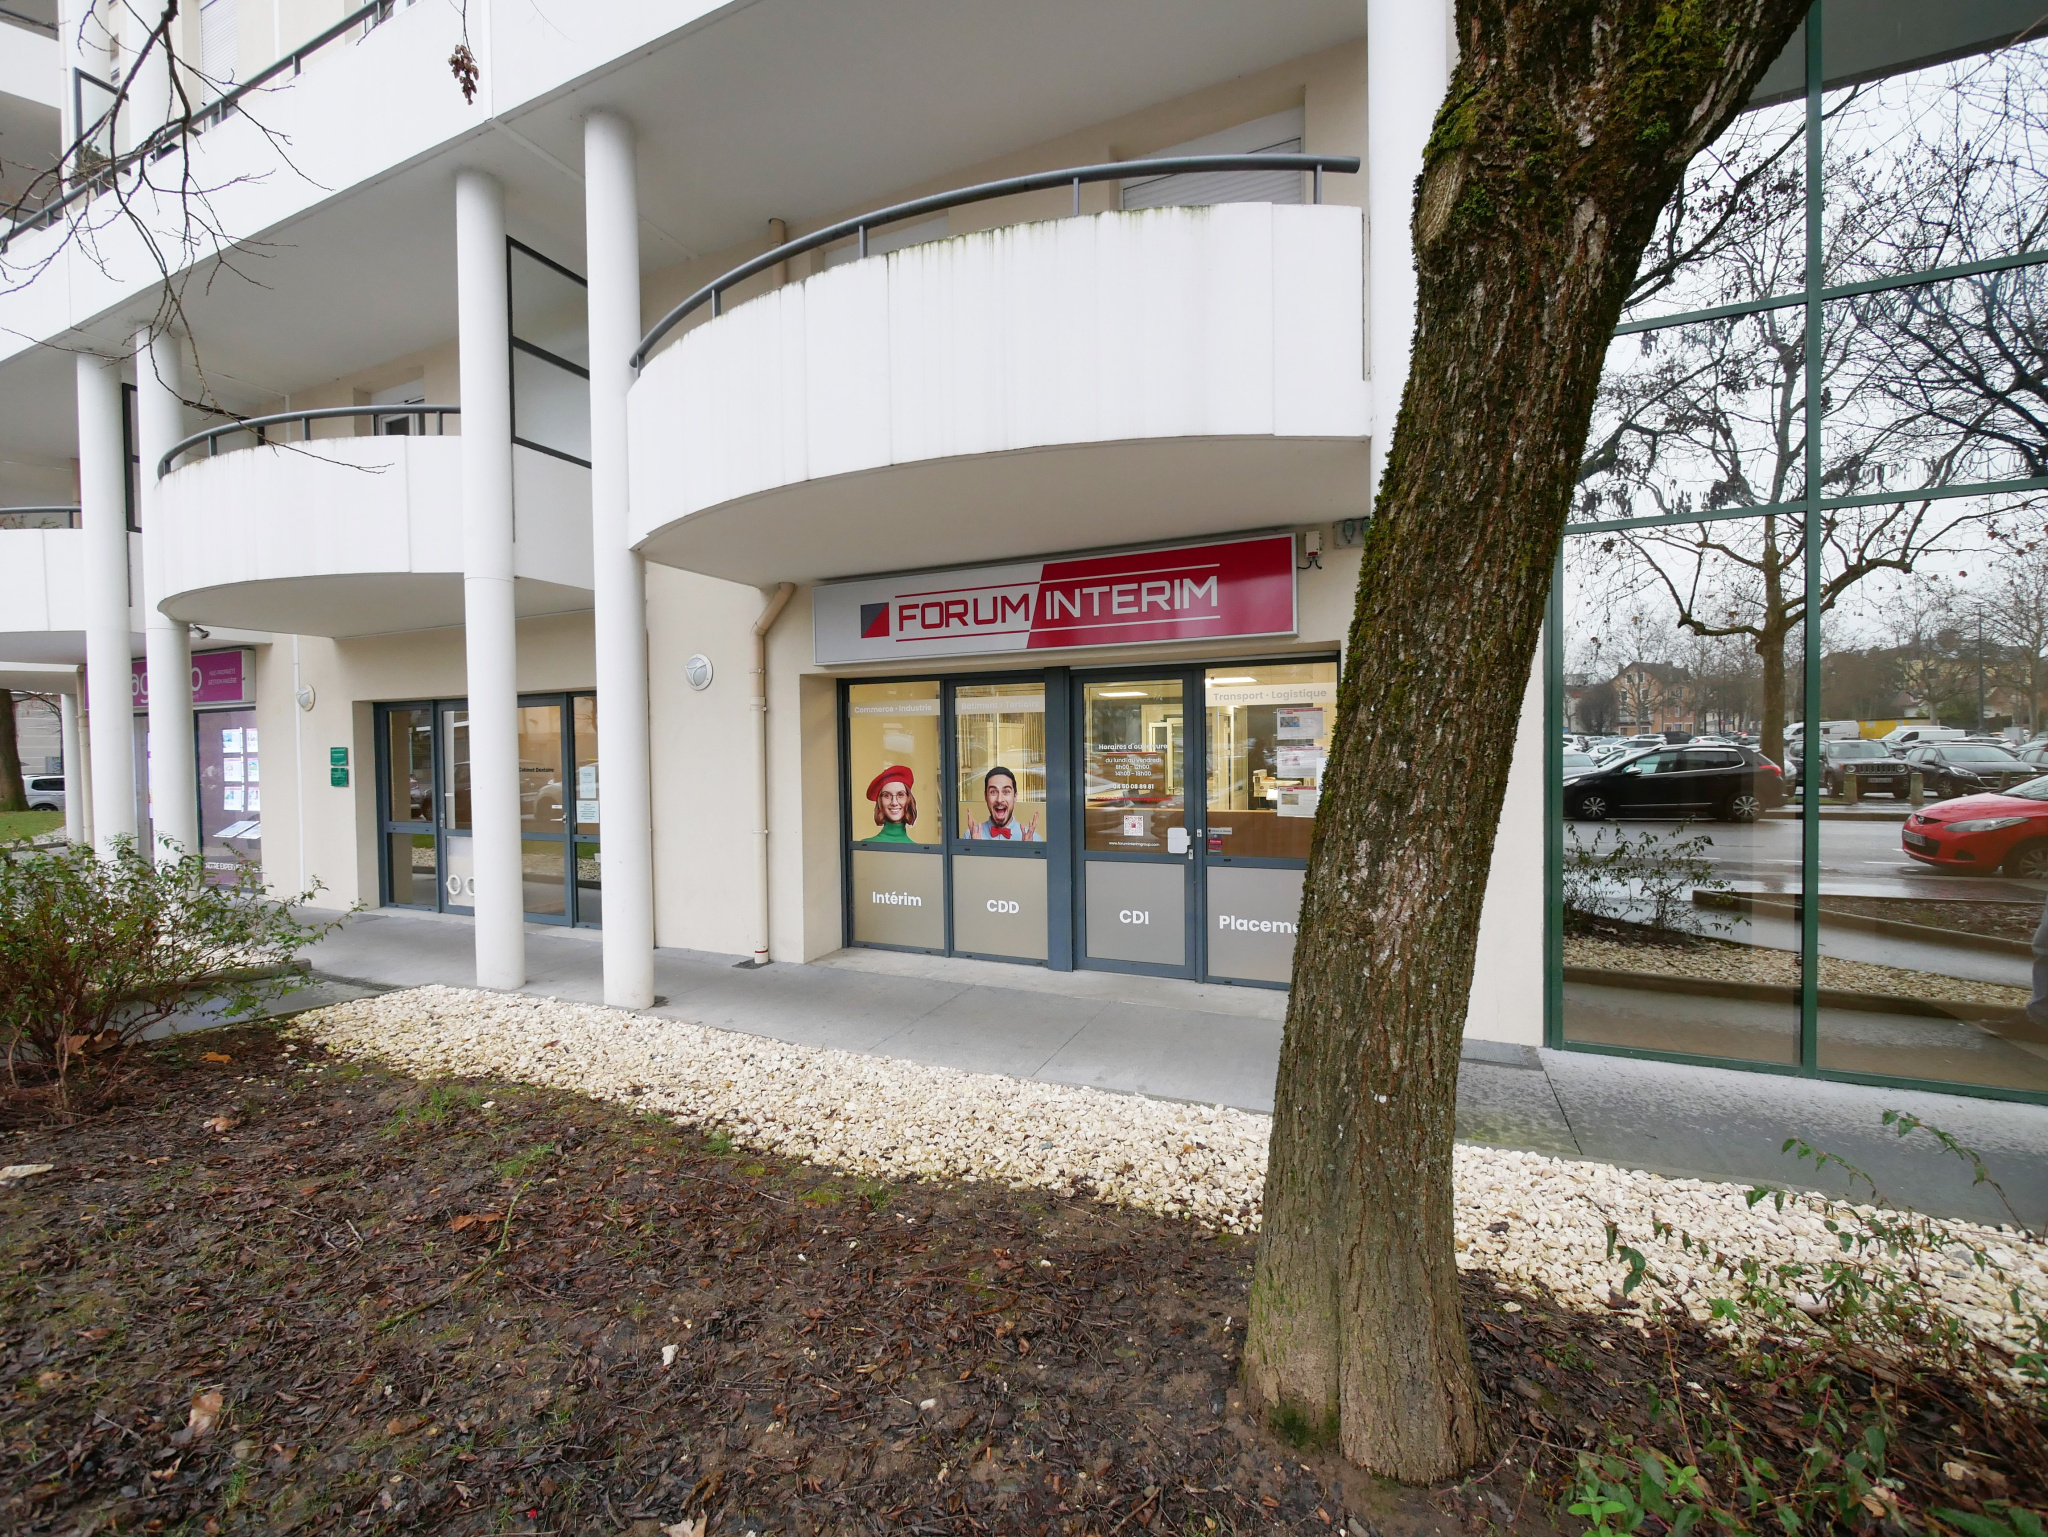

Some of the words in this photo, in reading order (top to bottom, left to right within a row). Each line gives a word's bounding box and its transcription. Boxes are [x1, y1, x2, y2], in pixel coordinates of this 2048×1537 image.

[898, 593, 1030, 632] FORUM
[1045, 575, 1218, 620] INTERIM
[1213, 691, 1264, 702] Transport
[1271, 689, 1327, 701] Logistique
[854, 705, 894, 714] Commerce
[899, 704, 932, 713] Industrie
[1005, 700, 1040, 709] Tertiaire
[871, 890, 922, 908] Intérim
[986, 899, 1020, 915] CDD
[1119, 909, 1150, 925] CDI
